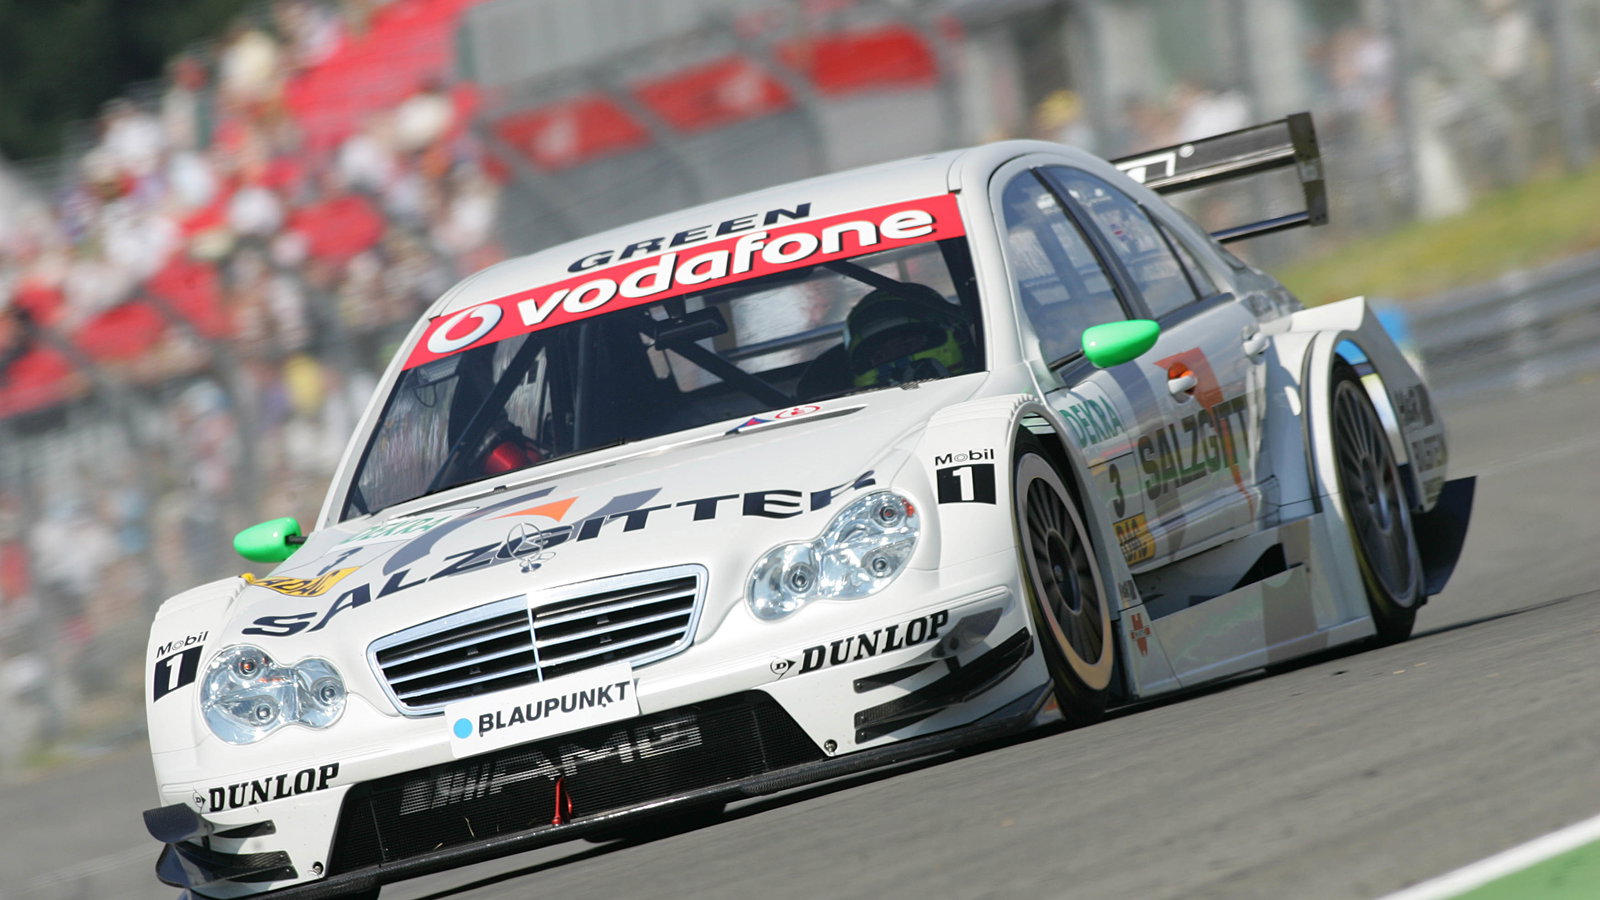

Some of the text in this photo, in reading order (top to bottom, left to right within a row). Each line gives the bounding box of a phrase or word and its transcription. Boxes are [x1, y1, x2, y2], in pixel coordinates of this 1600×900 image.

[568, 202, 812, 273] GREEN
[517, 209, 936, 327] vodafone
[1058, 395, 1124, 449] DEKRA
[934, 448, 994, 466] Mobil
[1108, 463, 1126, 519] 3
[241, 470, 877, 638] SALZGITTER
[340, 514, 452, 545] DEKRA
[257, 569, 340, 595] ADAC
[156, 631, 209, 658] Mobil
[799, 609, 949, 675] DUNLOP
[478, 681, 632, 735] BLAUPUNKT
[488, 713, 703, 795] AMG
[208, 762, 340, 812] DUNLOP
